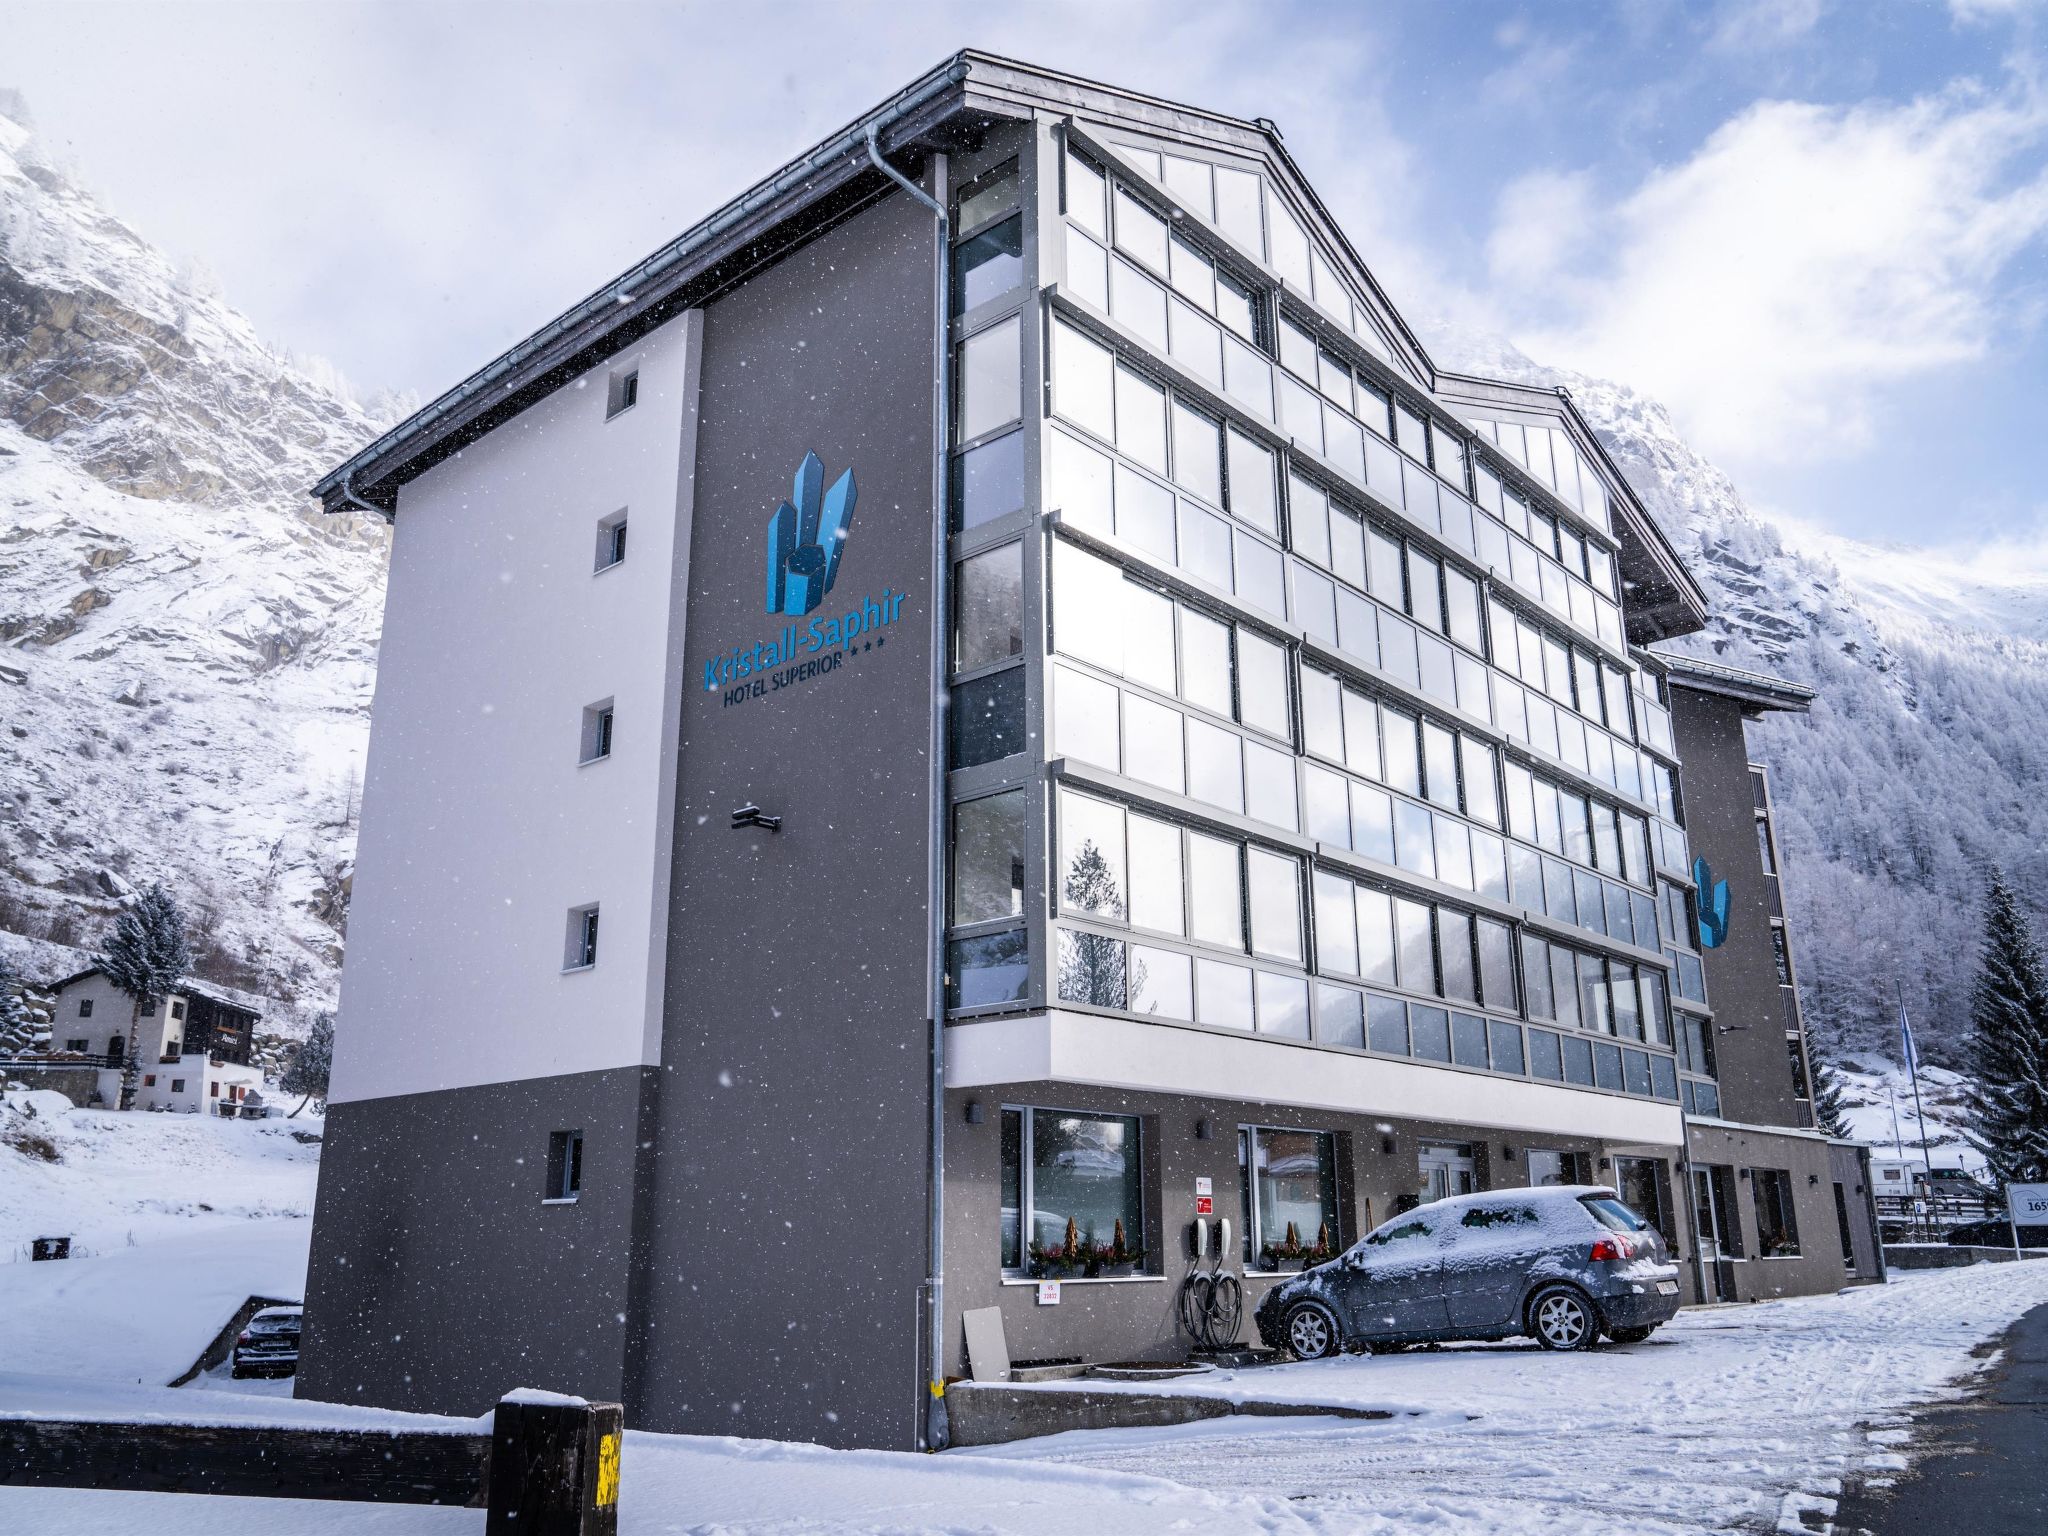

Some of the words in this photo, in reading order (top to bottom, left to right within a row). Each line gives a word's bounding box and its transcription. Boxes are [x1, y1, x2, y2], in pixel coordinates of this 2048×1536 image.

[703, 588, 906, 692] Kristall-Saphir
[723, 678, 768, 708] HOTEL
[771, 651, 843, 691] SUPERIOR
[2028, 1201, 2048, 1211] 165
